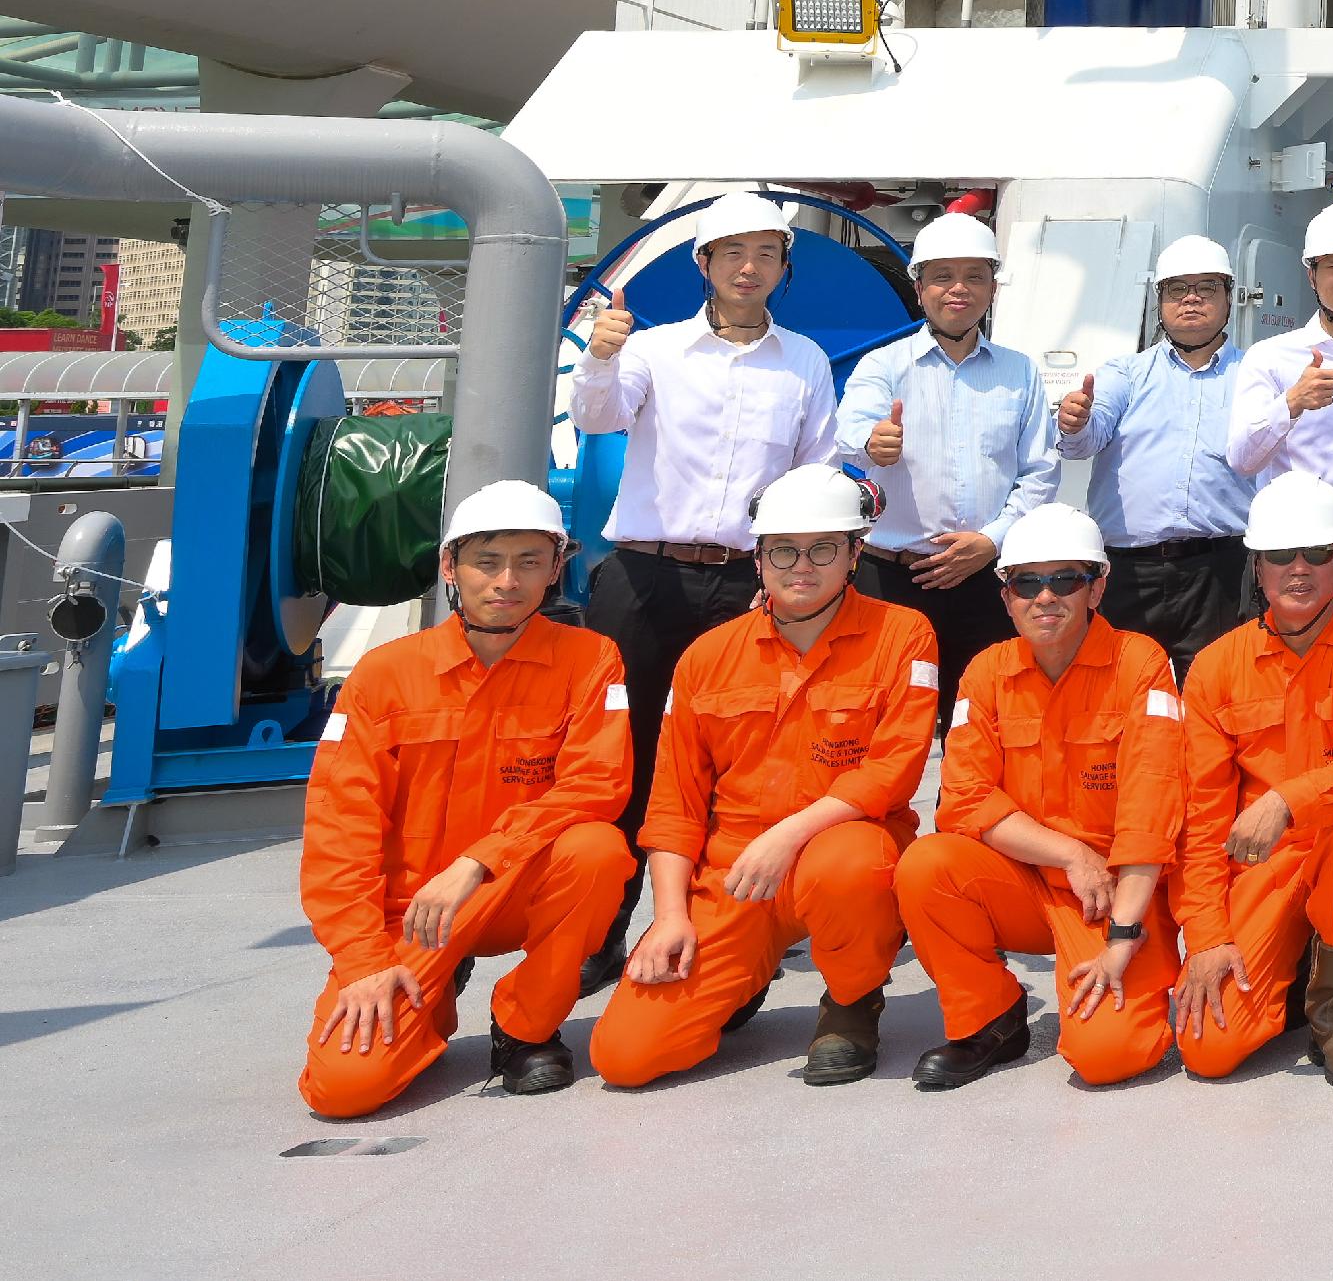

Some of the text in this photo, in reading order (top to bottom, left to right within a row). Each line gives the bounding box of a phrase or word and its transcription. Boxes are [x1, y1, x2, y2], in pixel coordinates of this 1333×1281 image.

[53, 333, 98, 345] LEARN DANCE
[1081, 771, 1109, 781] SALVAGE
[1082, 781, 1115, 791] SERVICES
